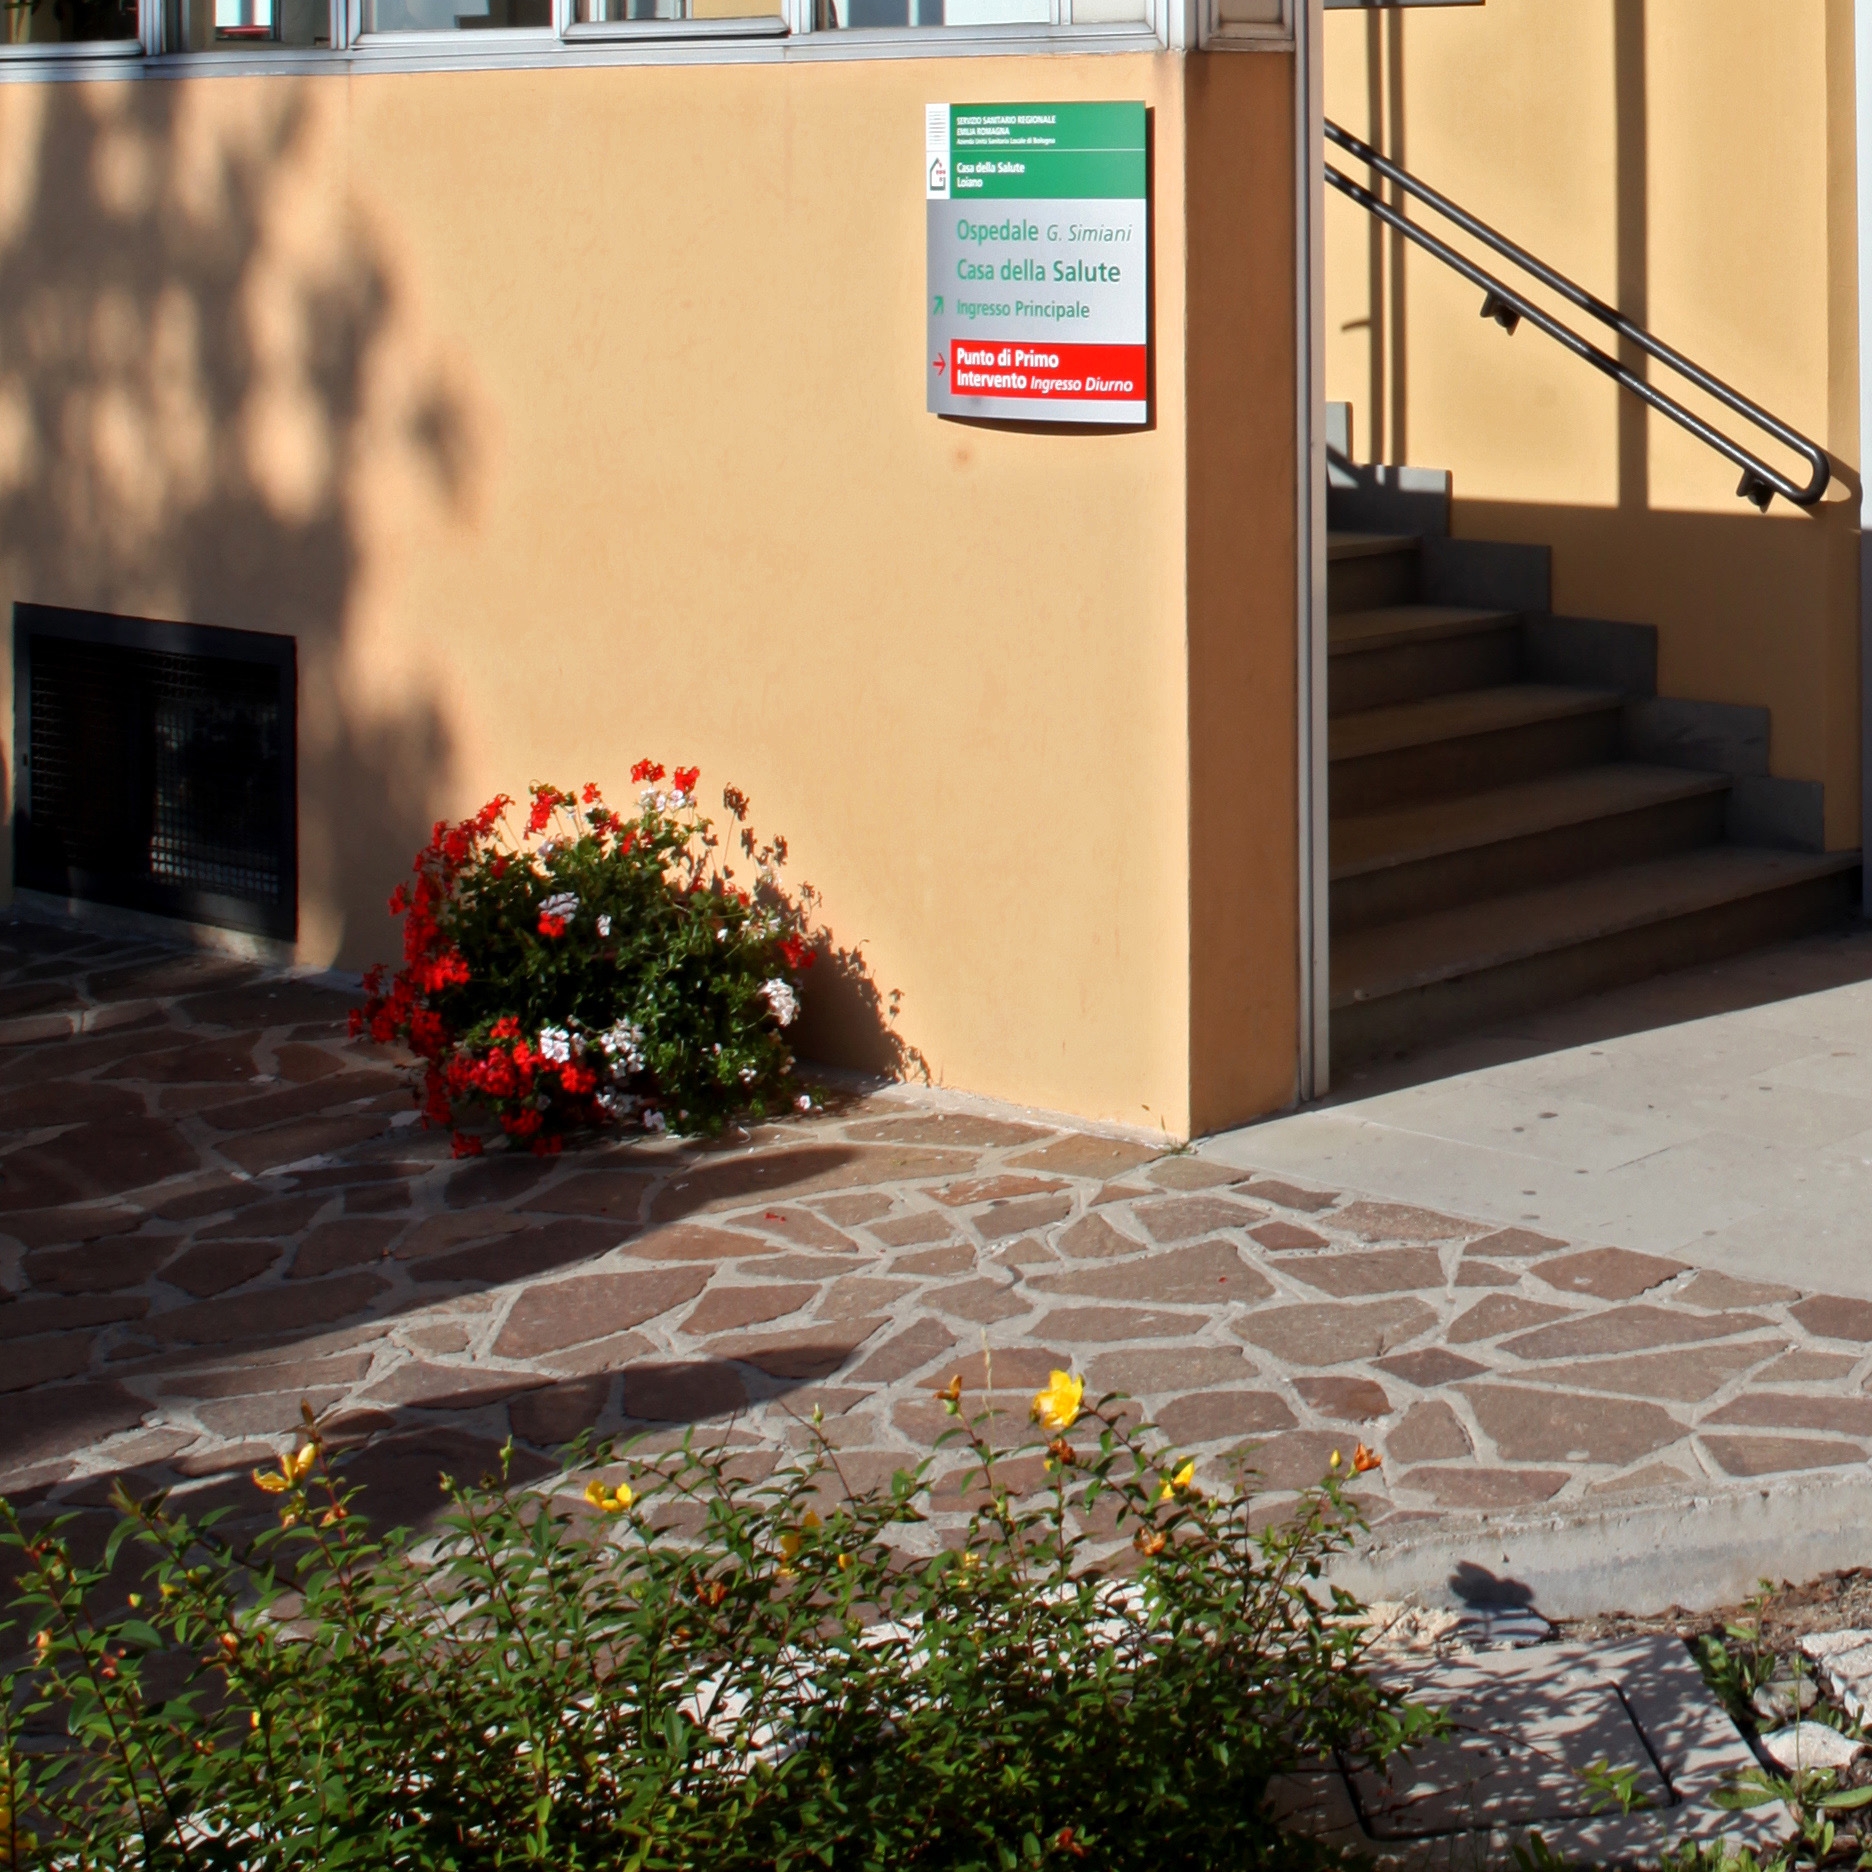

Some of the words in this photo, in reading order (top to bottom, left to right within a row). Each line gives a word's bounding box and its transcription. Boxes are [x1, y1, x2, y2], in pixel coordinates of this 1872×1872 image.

[956, 162, 975, 173] Casa
[975, 162, 996, 173] della
[997, 162, 1026, 173] Salute
[956, 176, 983, 188] Loiano
[956, 219, 1038, 246] Ospedale
[1047, 225, 1061, 241] G.
[1068, 224, 1131, 241] Simiani
[957, 259, 994, 280] Casa
[1001, 259, 1045, 281] della
[1053, 259, 1120, 282] Salute
[956, 299, 1010, 320] Ingresso
[1015, 300, 1089, 321] Principale
[957, 347, 995, 366] Punto
[997, 348, 1011, 367] di
[1015, 349, 1059, 369] Primo
[957, 370, 1027, 389] Intervento
[1030, 376, 1082, 394] Ingresso
[1085, 377, 1133, 392] Diurno
